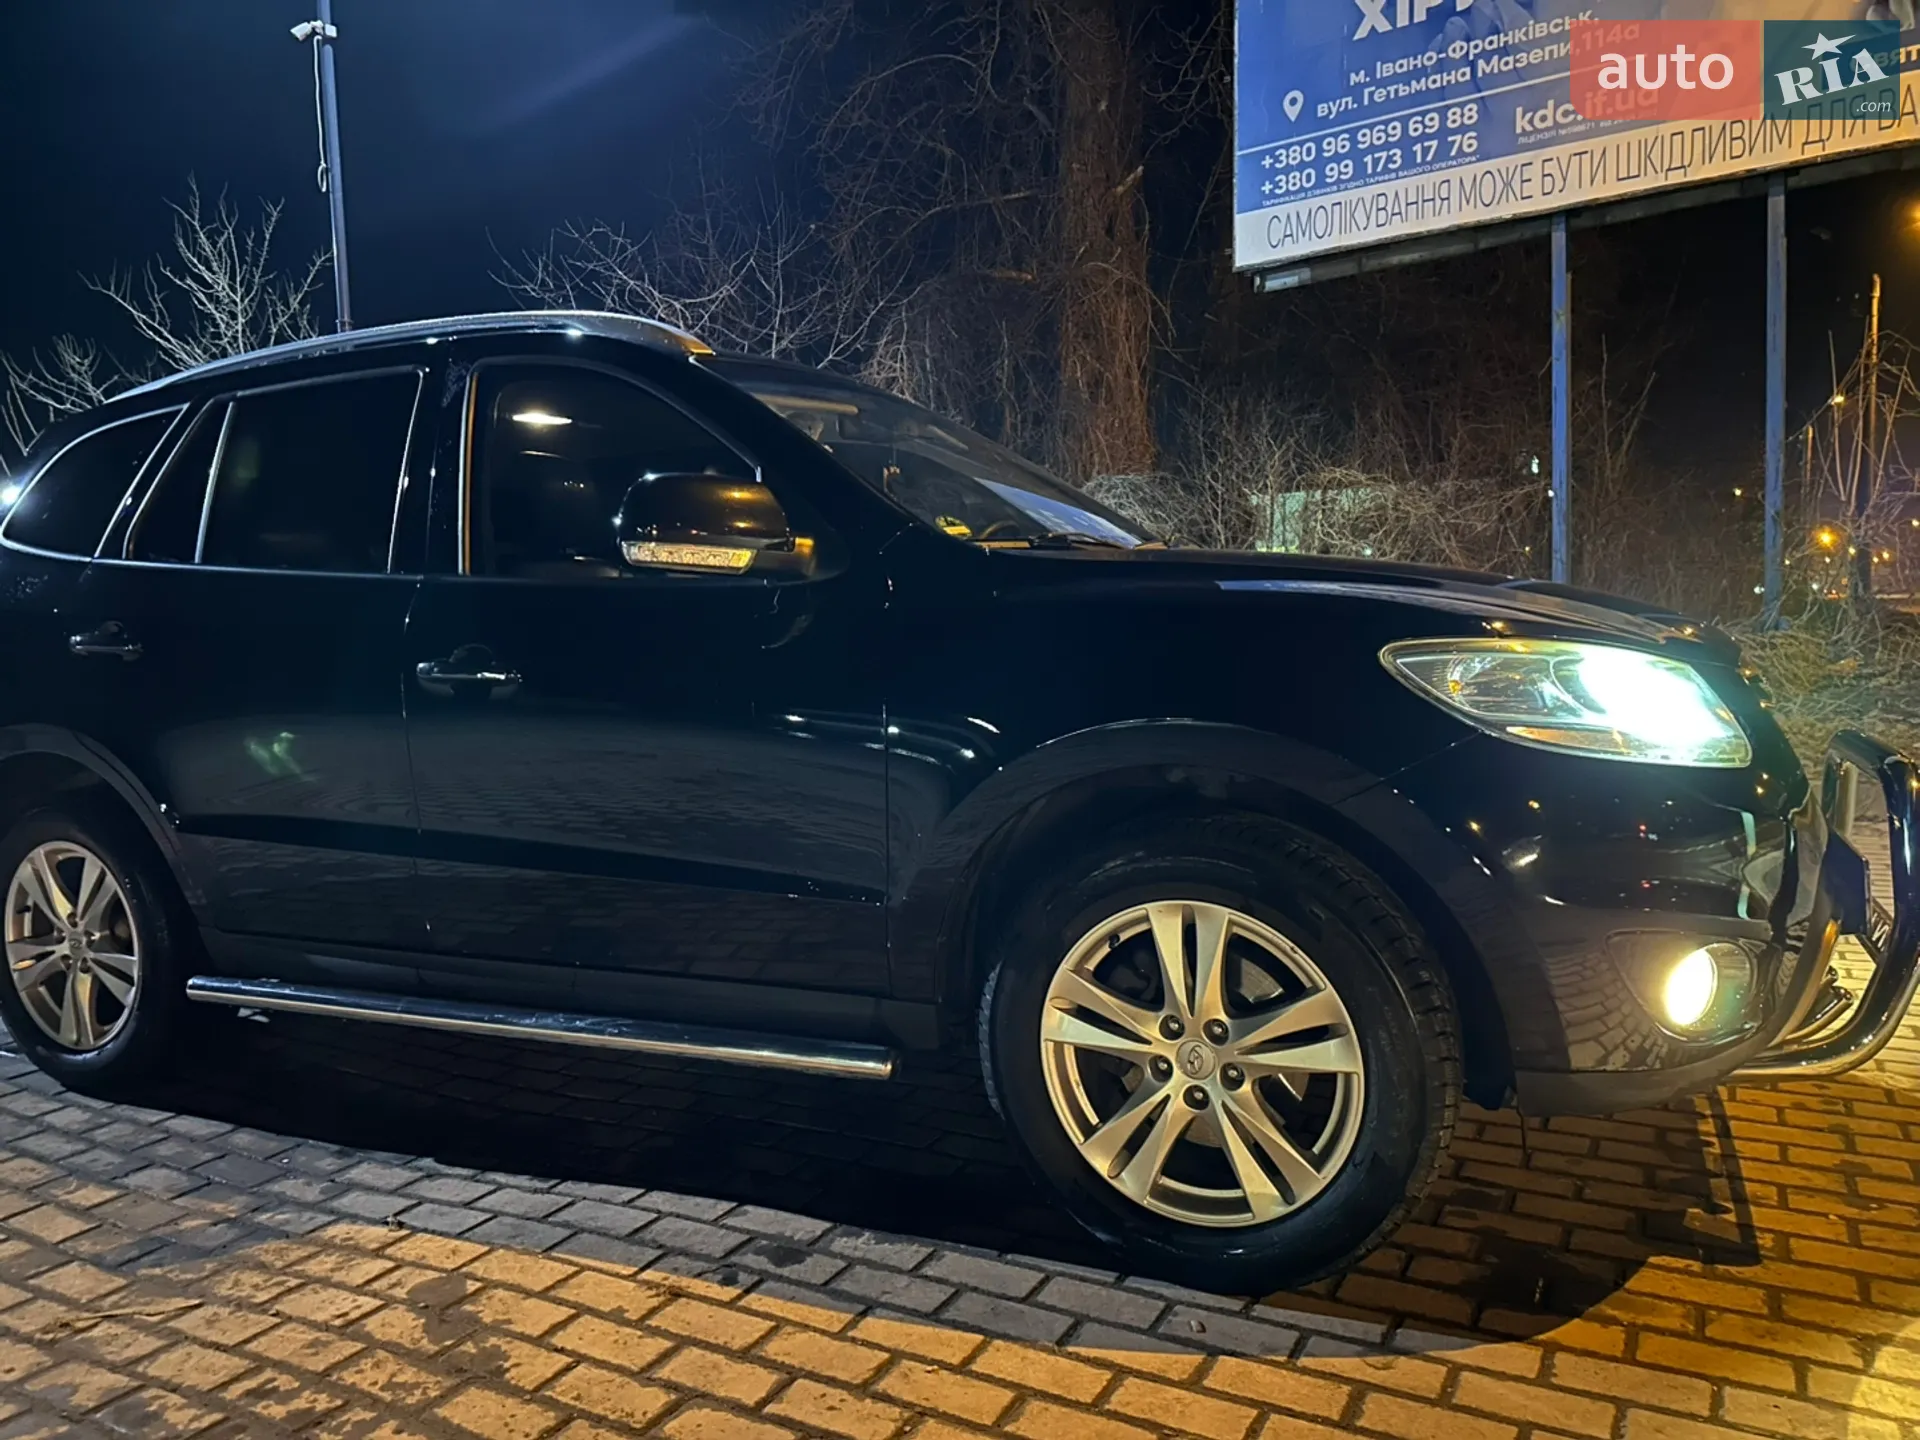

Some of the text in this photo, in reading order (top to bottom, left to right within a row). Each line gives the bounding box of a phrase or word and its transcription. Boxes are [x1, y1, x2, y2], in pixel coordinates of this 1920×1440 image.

[1317, 96, 1358, 119] вул.
[1363, 67, 1471, 105] Гетьмана
[1349, 71, 1370, 86] м.
[1261, 103, 1479, 169] +380 96 969 69 88
[1261, 131, 1479, 195] +380 99 173 17 76
[1266, 178, 1450, 249] САМОЛІКУВАННЯ
[1458, 162, 1533, 212] МОЖЕ
[1541, 147, 1607, 196] БУТИ
[1616, 106, 1793, 182] ШКІДЛИВИМ
[1801, 94, 1867, 156] ДЛЯ
